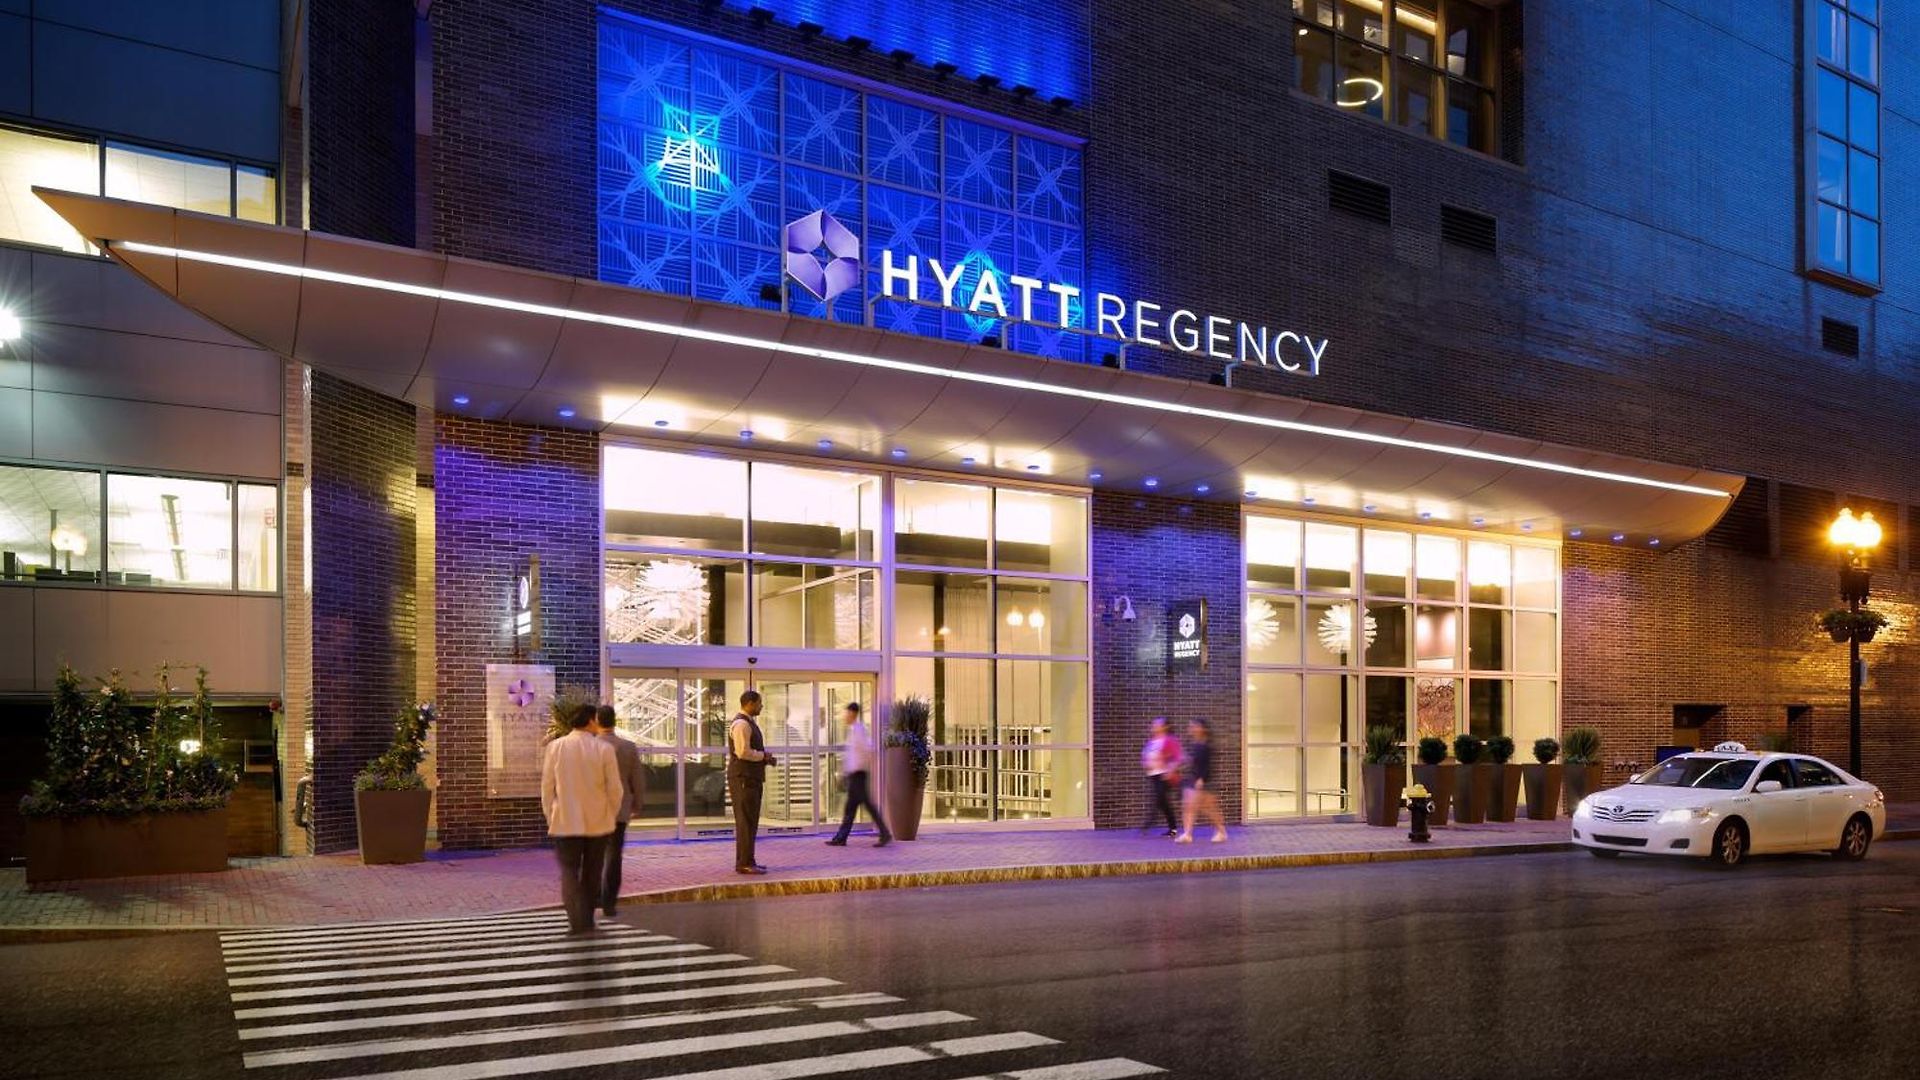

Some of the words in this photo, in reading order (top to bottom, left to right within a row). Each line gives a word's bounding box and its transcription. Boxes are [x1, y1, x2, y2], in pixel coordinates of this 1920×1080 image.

[882, 249, 1081, 329] HYATT
[1097, 292, 1329, 376] REGENCY
[1173, 640, 1200, 651] HYATT
